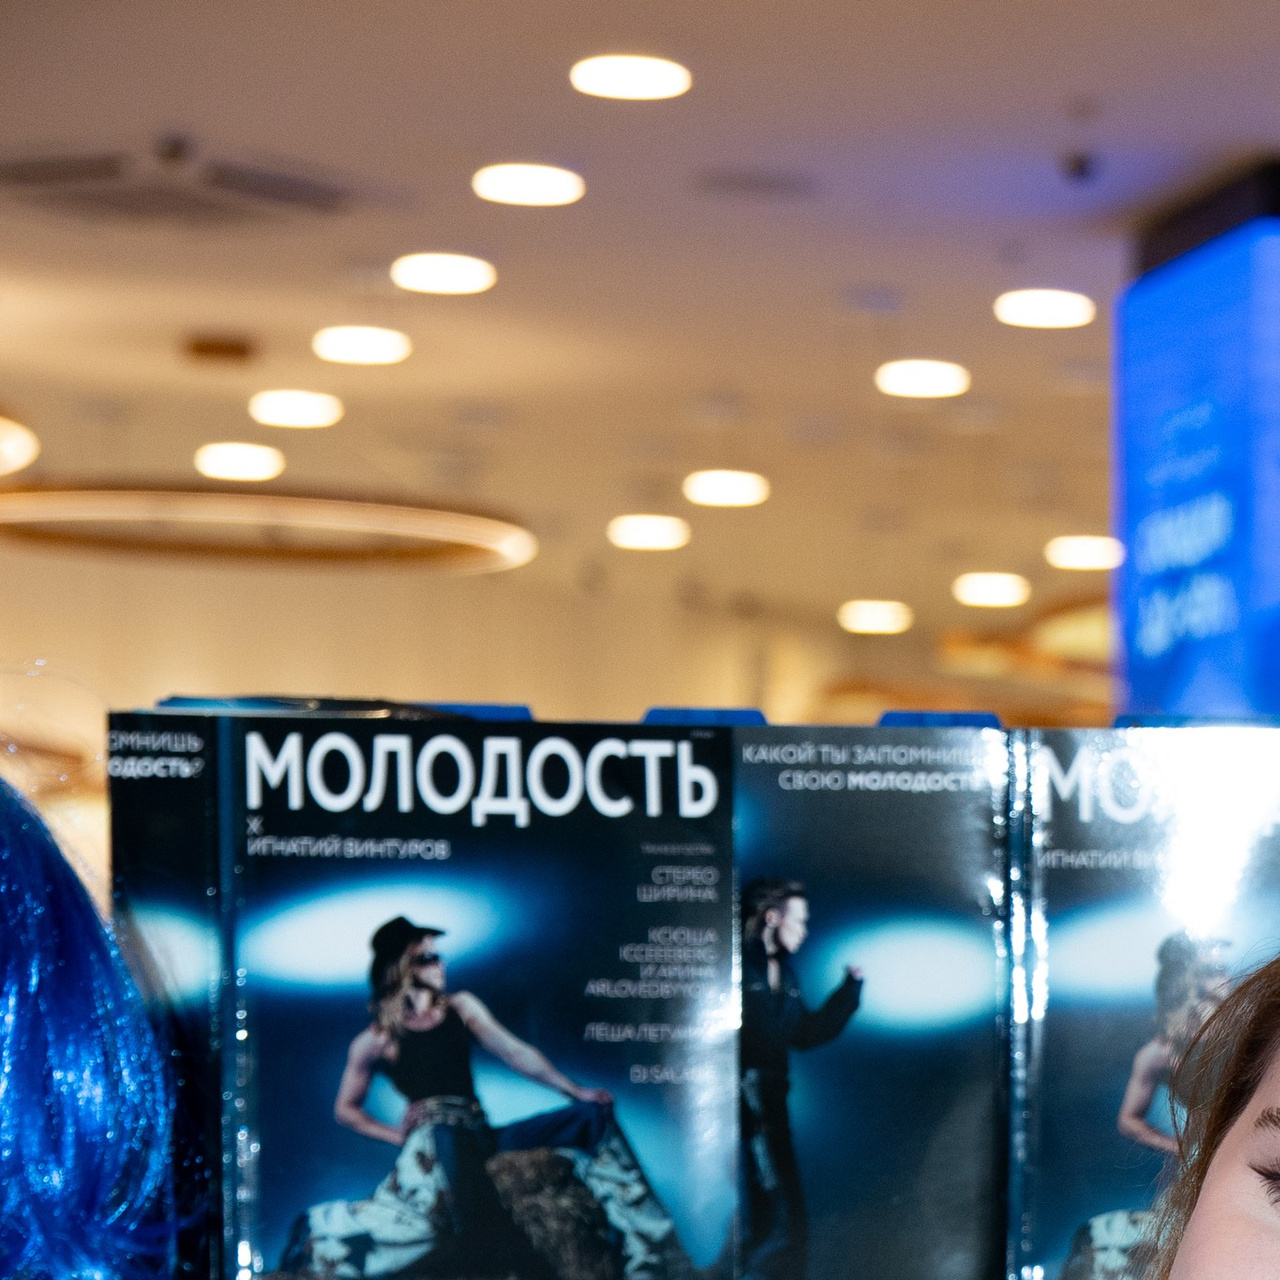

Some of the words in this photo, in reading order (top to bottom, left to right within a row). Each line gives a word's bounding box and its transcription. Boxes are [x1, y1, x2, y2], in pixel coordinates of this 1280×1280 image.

[742, 741, 816, 764] КАКОЙ
[820, 745, 848, 764] ТЫ
[246, 731, 720, 827] МОЛОДОСТЬ
[779, 769, 845, 790] СВОЮ
[248, 835, 342, 857] ИГНАТИЙ
[343, 837, 450, 860] ВИНТУРОВ
